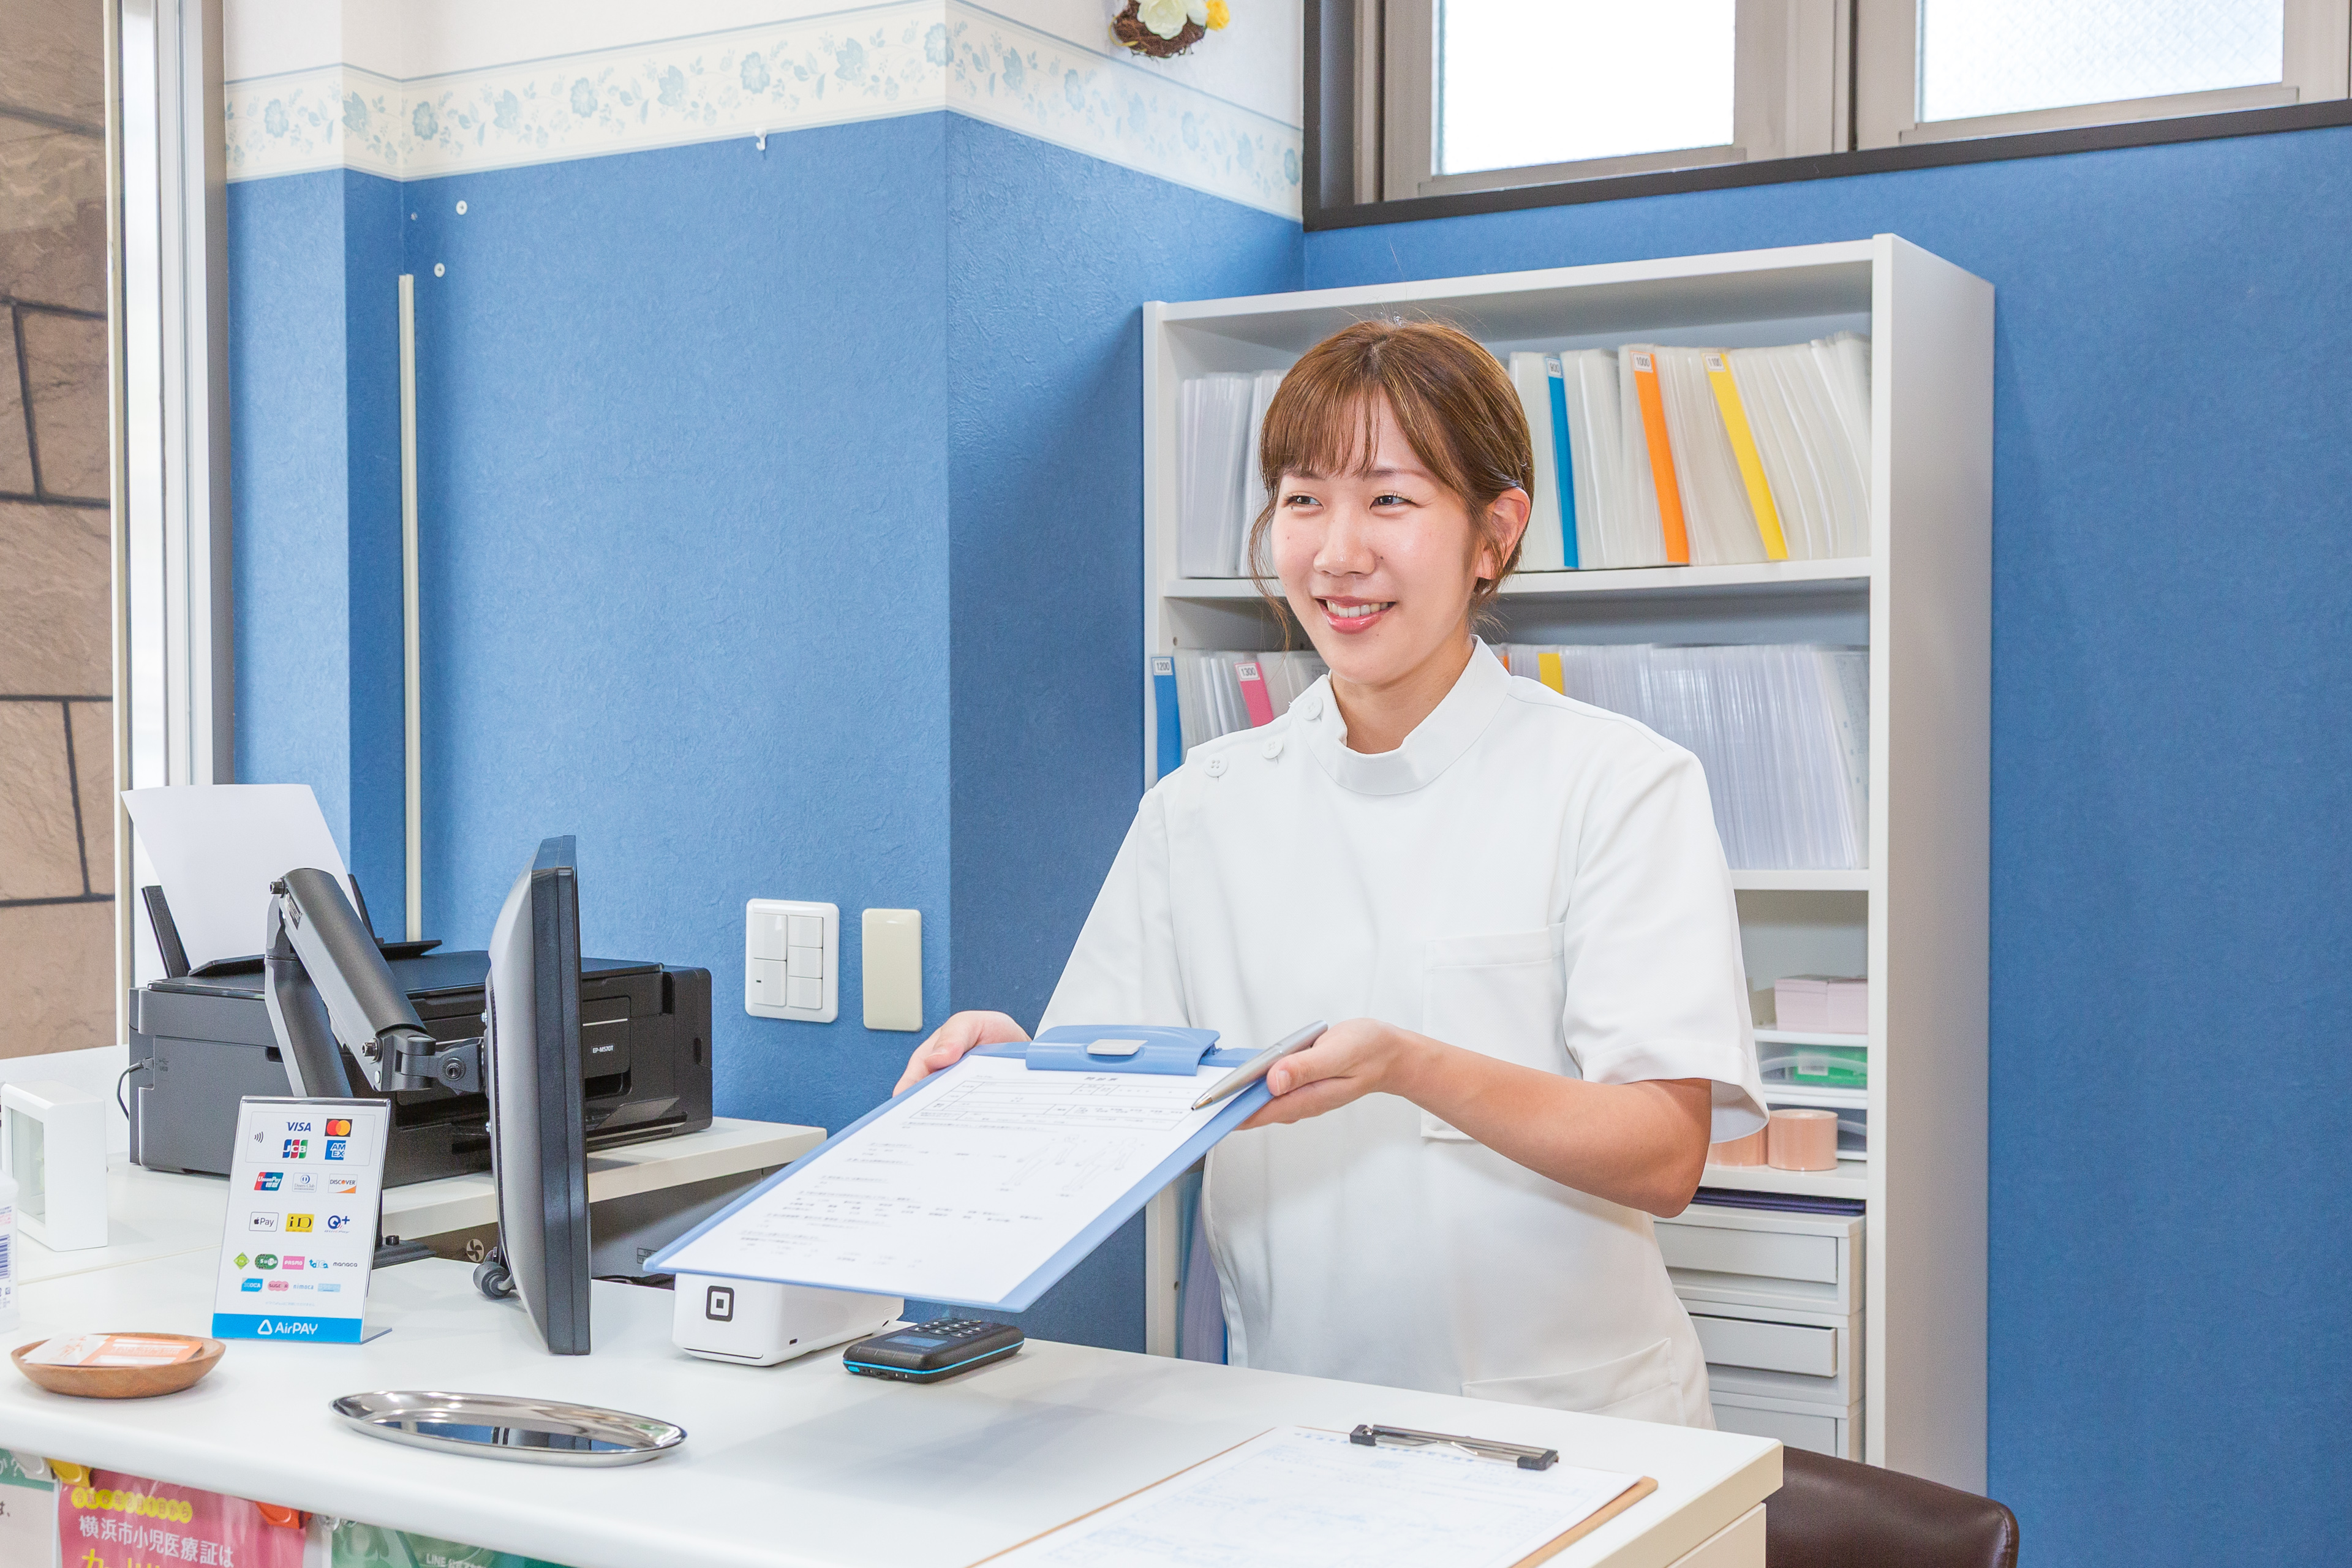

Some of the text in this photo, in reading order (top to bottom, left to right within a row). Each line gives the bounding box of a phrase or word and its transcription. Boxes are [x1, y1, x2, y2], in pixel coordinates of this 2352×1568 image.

[1636, 356, 1651, 368] 1000
[1156, 662, 1170, 671] 1200
[1241, 667, 1256, 676] 1300
[286, 1121, 311, 1132] VISA
[260, 1217, 274, 1227] Pay
[274, 1322, 318, 1335] AirPAY
[79, 1514, 234, 1568] 横浜市小児医療証は
